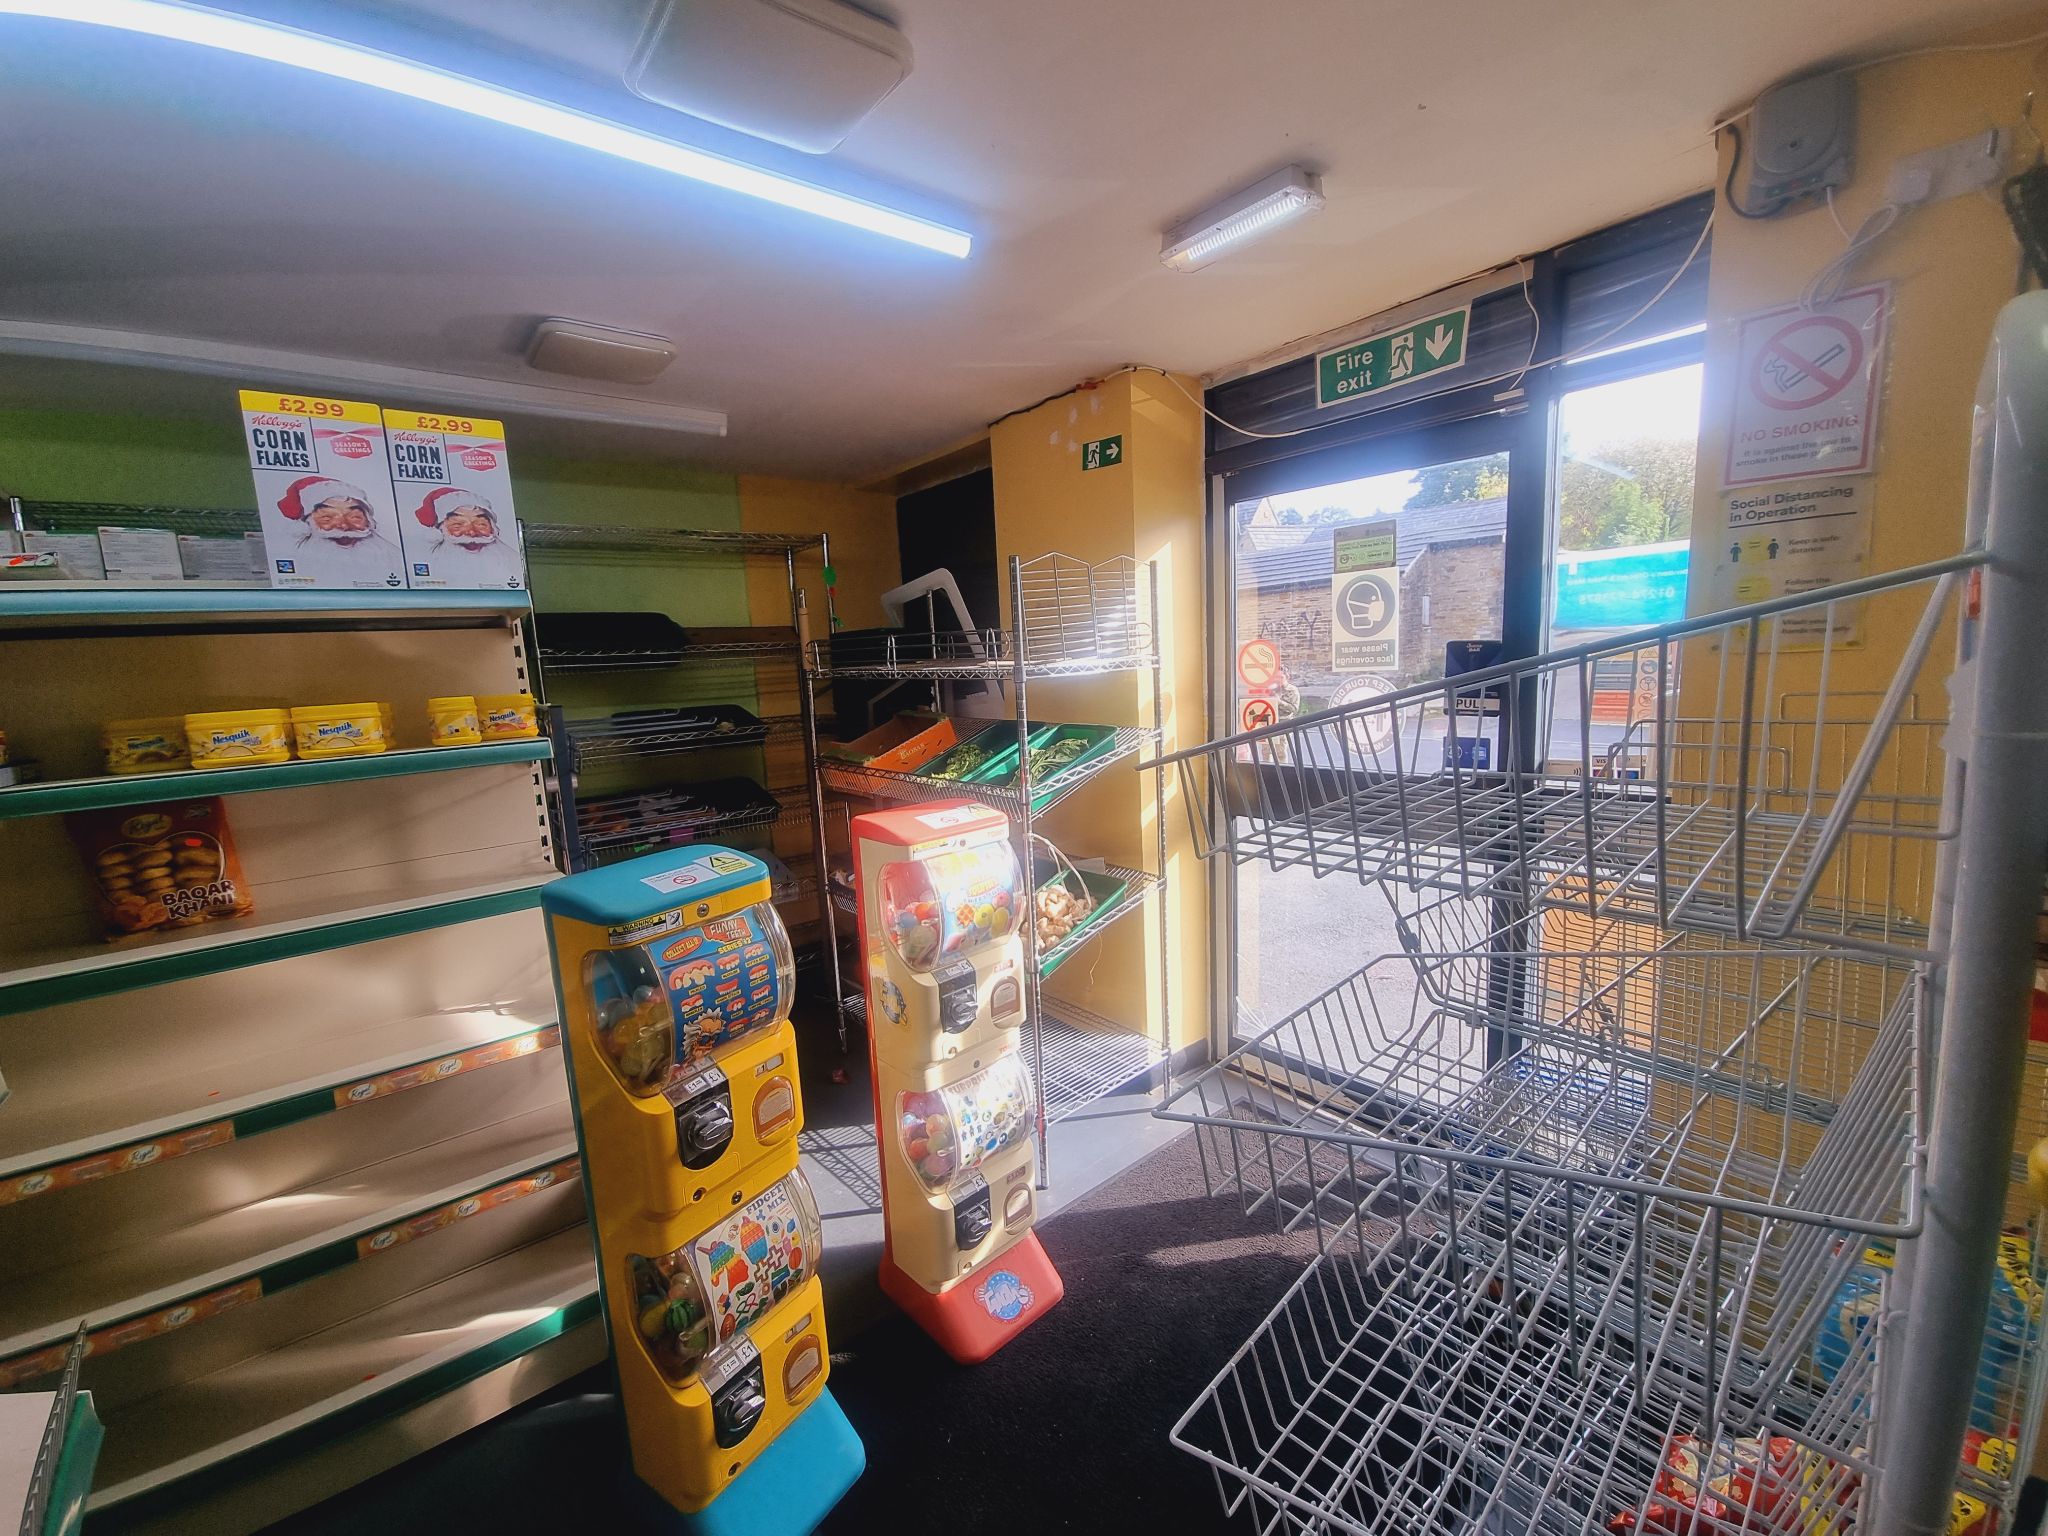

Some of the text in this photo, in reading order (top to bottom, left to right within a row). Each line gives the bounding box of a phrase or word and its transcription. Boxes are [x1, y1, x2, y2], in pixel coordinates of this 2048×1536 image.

[1336, 350, 1374, 374] Fire
[1336, 370, 1373, 395] exit
[278, 397, 345, 418] £2.99
[252, 414, 305, 430] Kellogg's
[416, 416, 473, 433] £2.99
[1742, 414, 1859, 442] NO SMOKING
[252, 428, 308, 452] CORN
[394, 431, 438, 446] Kellogg's
[394, 444, 442, 465] CORN
[1764, 444, 1800, 455] against
[1802, 441, 1818, 449] the
[256, 450, 311, 468] FLAKES
[1736, 457, 1768, 467] smoke
[1769, 455, 1779, 463] in
[1781, 451, 1809, 461] these
[397, 463, 444, 480] FLAKES
[1730, 486, 1854, 510] Social Distancing
[1729, 503, 1817, 523] in Operation
[1788, 538, 1810, 547] Keep
[489, 710, 517, 723] Nesquik
[213, 729, 251, 745] Nesquik
[318, 721, 353, 737] Nesquik
[160, 880, 235, 907] BAQAR
[168, 892, 236, 921] KHANI
[622, 917, 654, 933] WARNING
[709, 918, 738, 936] FUNNY
[726, 928, 747, 940] TEETH
[718, 940, 743, 954] SERIES
[745, 1182, 783, 1215] FIDGET
[766, 1193, 787, 1212] MIX
[741, 1344, 754, 1359] £1
